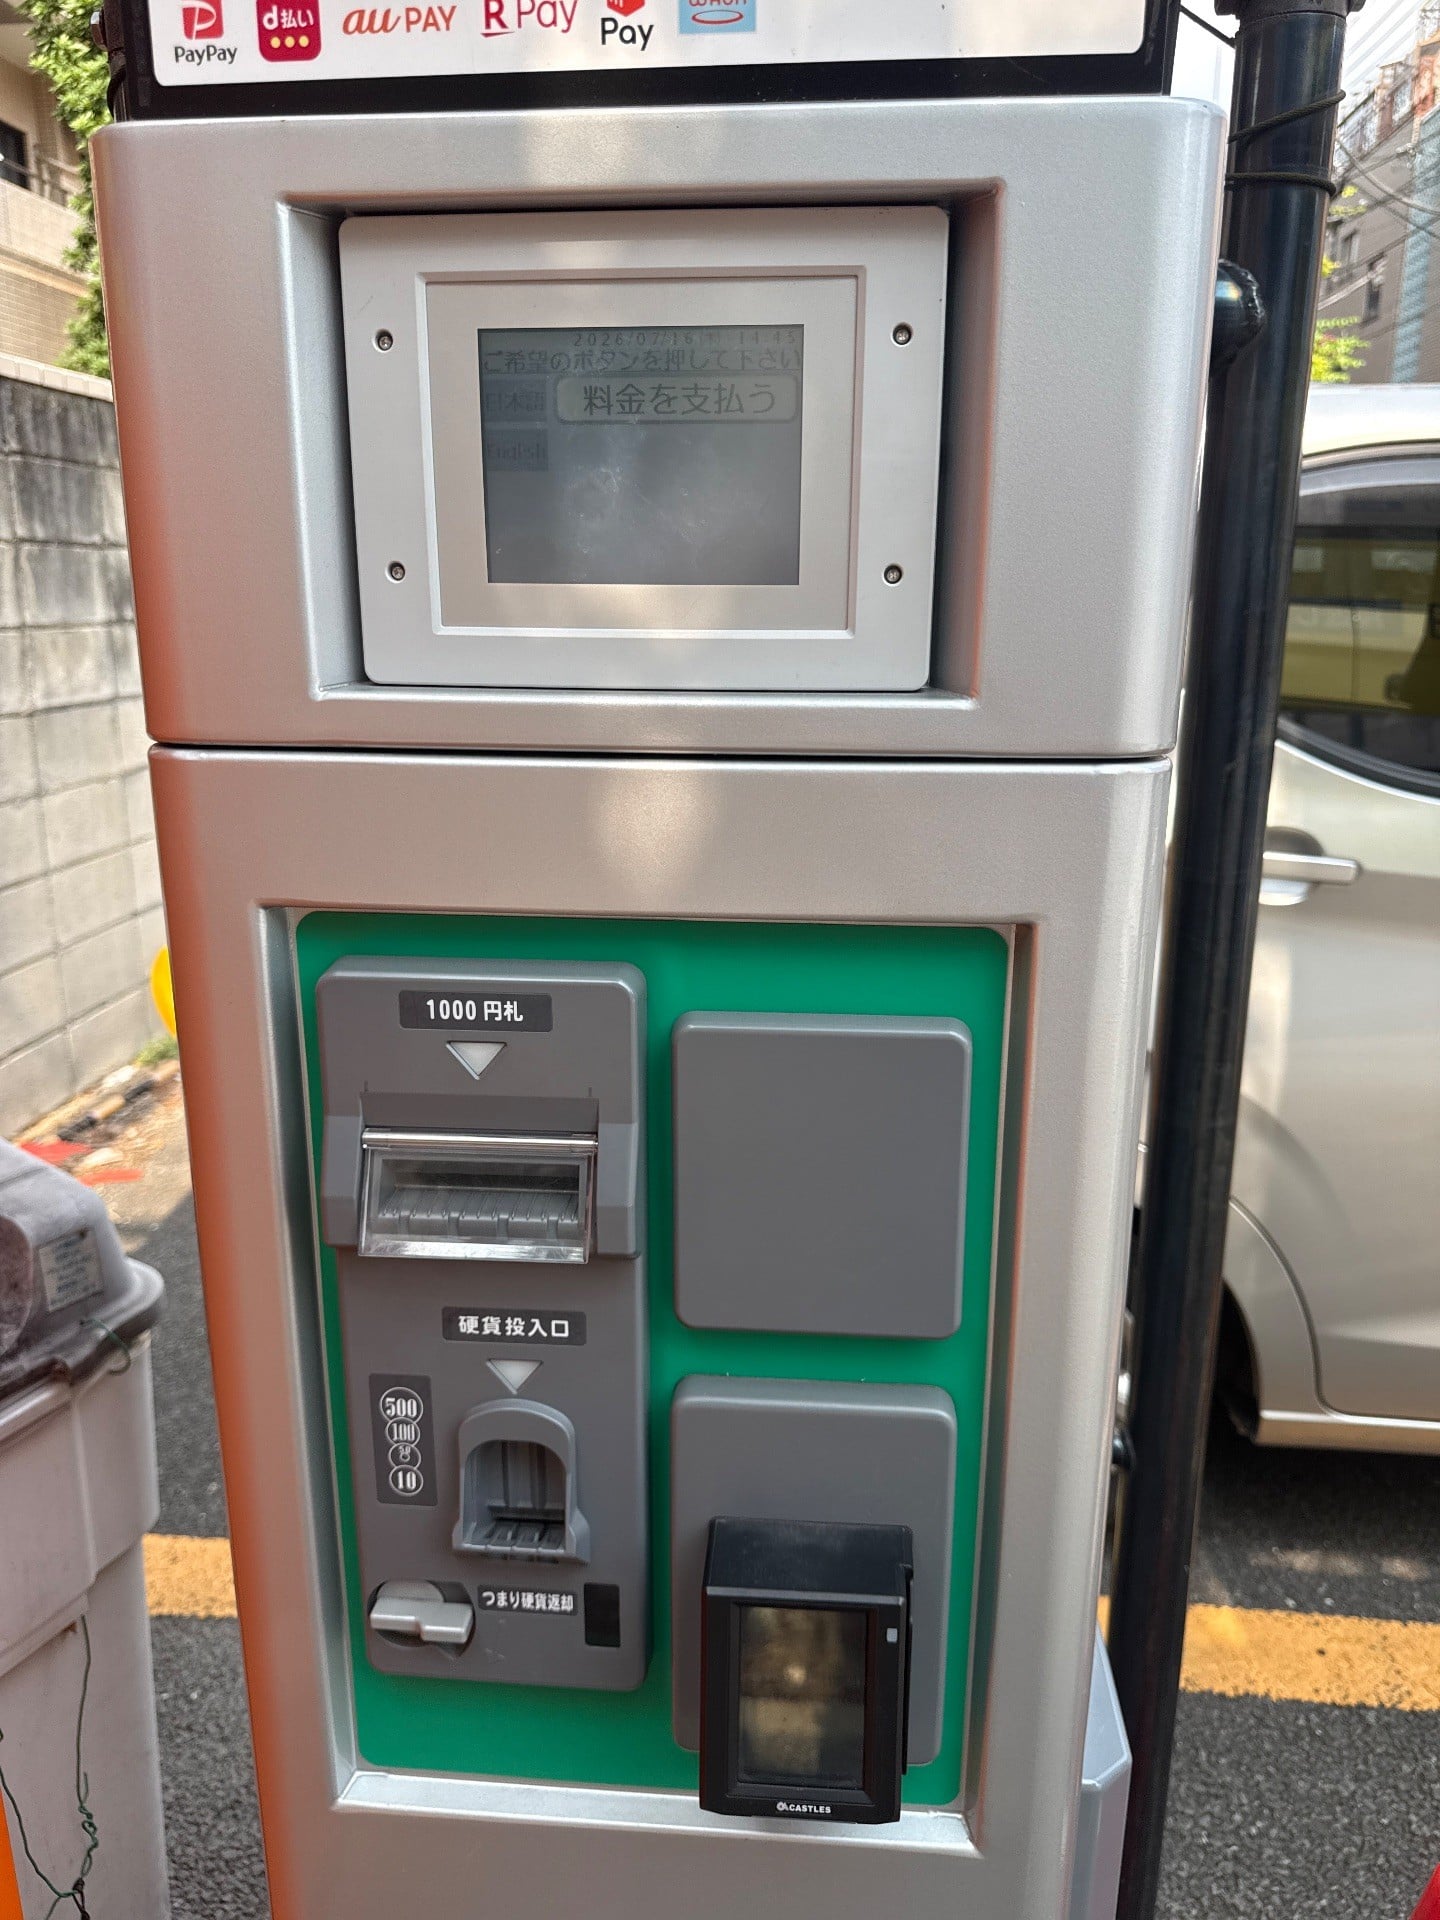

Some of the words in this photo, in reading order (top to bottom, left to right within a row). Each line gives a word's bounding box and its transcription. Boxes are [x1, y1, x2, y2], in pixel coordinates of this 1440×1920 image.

[263, 5, 314, 31] d払い
[342, 8, 401, 35] au
[405, 6, 457, 33] PAY
[483, 0, 511, 33] R
[517, 0, 578, 34] Pay
[600, 17, 654, 51] Pay
[174, 45, 238, 66] PayPay
[583, 383, 775, 416] 料金を支払う
[426, 999, 477, 1021] 1000
[483, 1000, 524, 1022] 円札
[458, 1315, 569, 1338] 硬貨投入口
[385, 1397, 418, 1418] 500
[392, 1423, 416, 1441] 100
[397, 1471, 417, 1490] 10
[482, 1590, 574, 1612] つまり硬貨返却
[788, 1803, 832, 1814] CASTLES
